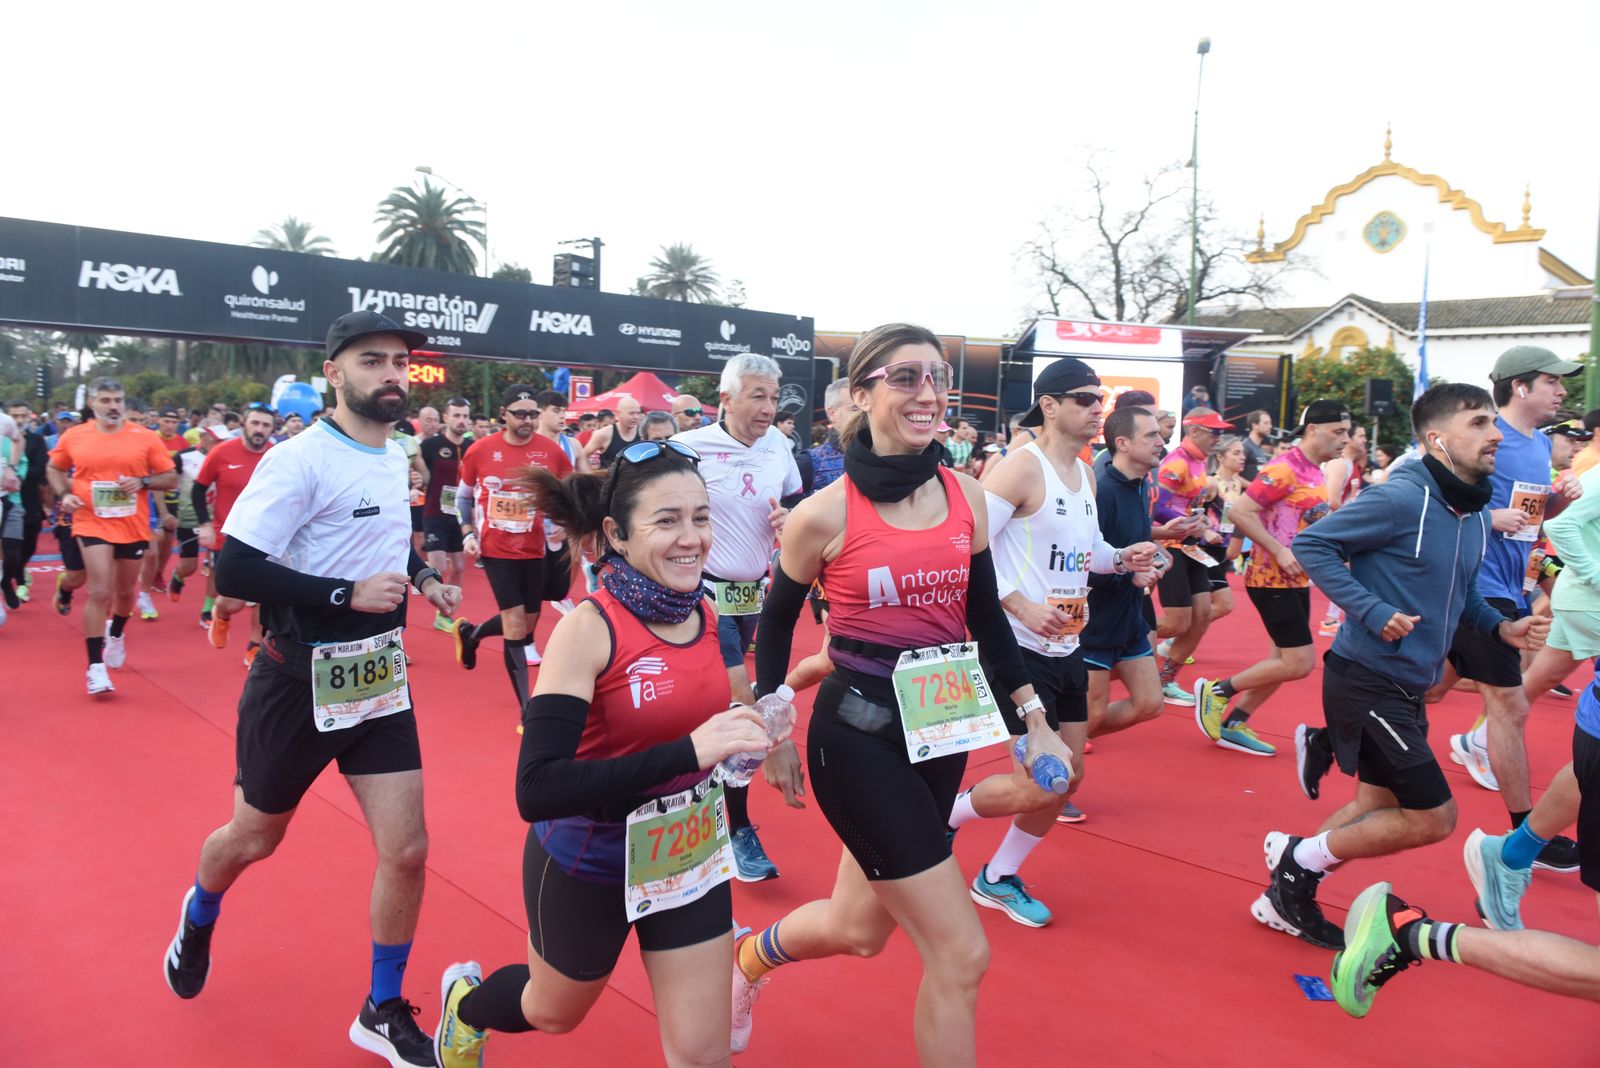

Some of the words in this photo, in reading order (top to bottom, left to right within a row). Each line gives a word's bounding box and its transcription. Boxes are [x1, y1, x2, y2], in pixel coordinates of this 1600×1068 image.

[78, 260, 184, 296] HOKA
[378, 289, 478, 316] maratón
[403, 311, 480, 334] sevilla
[529, 309, 596, 337] HOKA
[637, 325, 682, 339] HYUNDAI
[436, 336, 462, 347] 2024
[330, 655, 389, 690] 8183
[911, 668, 975, 709] 7284
[635, 802, 656, 818] MEDIO
[647, 804, 712, 863] 7285
